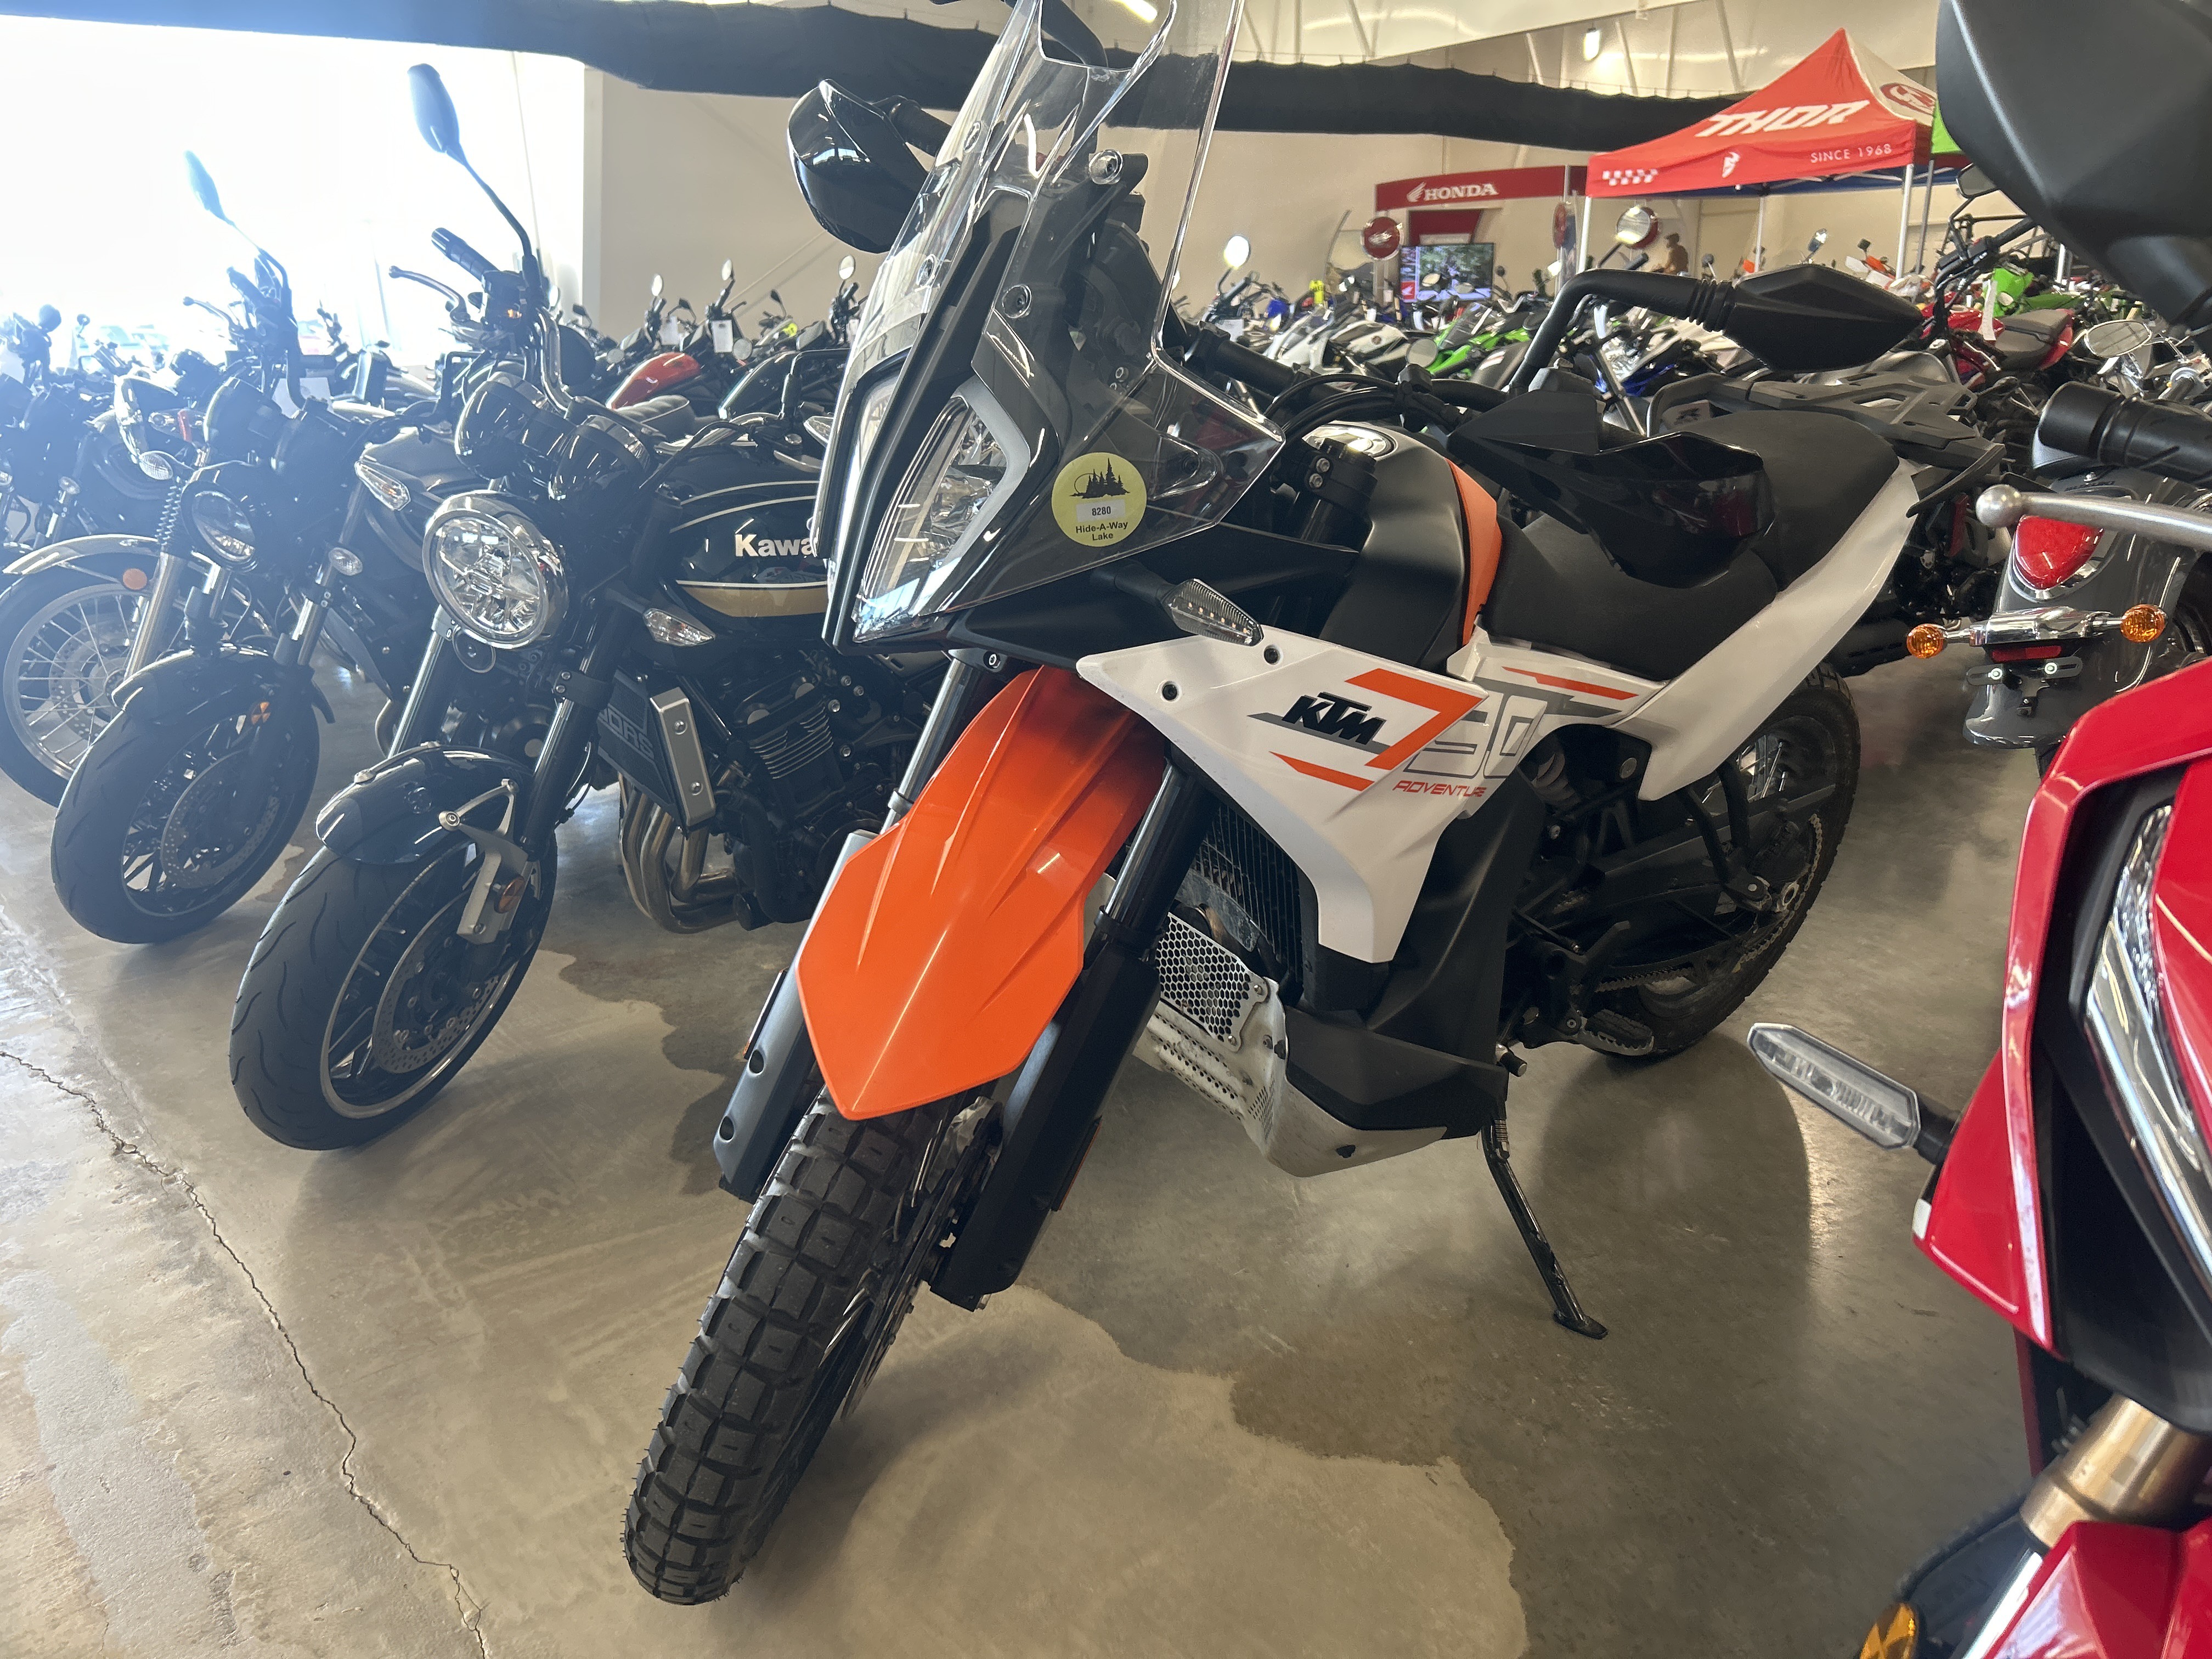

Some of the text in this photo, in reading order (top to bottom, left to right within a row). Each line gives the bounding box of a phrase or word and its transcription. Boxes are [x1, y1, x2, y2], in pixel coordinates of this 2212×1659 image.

[1694, 100, 1870, 137] THOR
[1810, 143, 1892, 163] SINCE 1968
[1423, 183, 1499, 201] HONDA
[1092, 506, 1111, 516] 8280
[1076, 521, 1128, 533] Hide-A-Way
[1092, 532, 1113, 541] Lake
[1282, 692, 1386, 745] KTM
